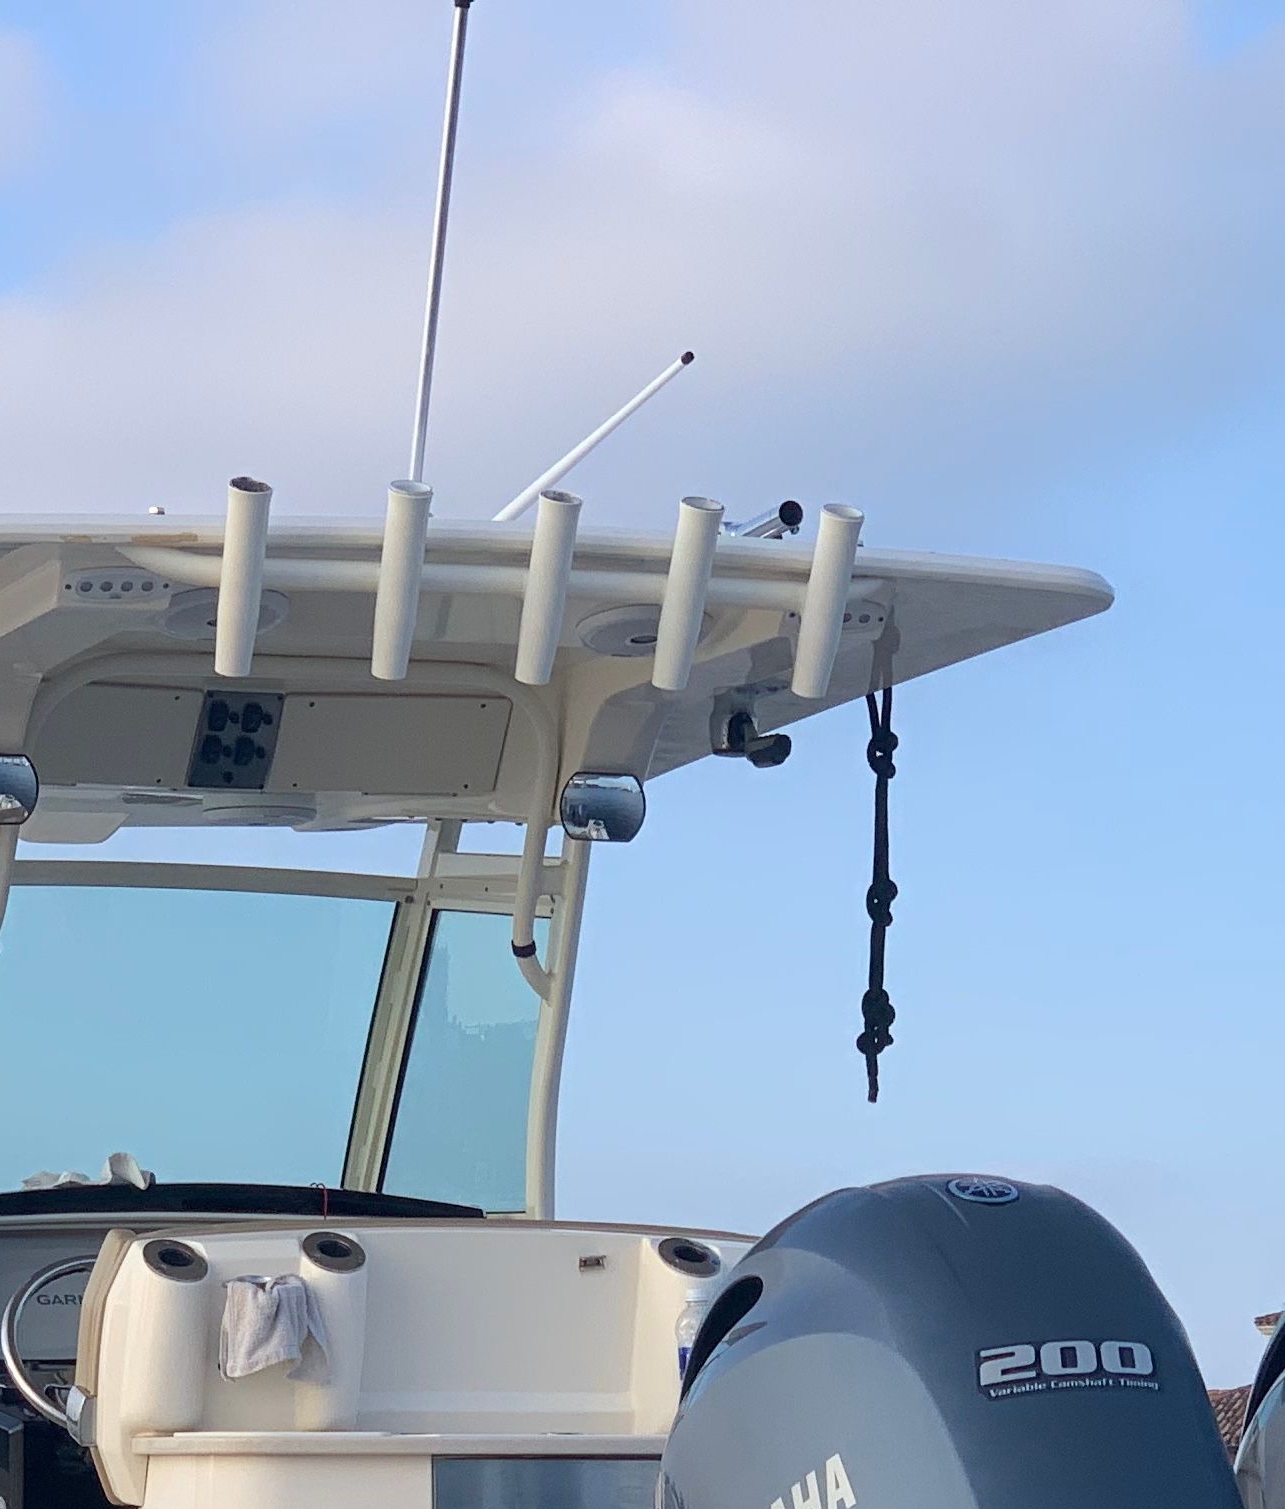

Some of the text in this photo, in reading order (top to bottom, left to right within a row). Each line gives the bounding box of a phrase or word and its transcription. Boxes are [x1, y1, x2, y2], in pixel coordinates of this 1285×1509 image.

[980, 1340, 1153, 1386] 200
[989, 1378, 1159, 1398] Variable Camshaft Timing
